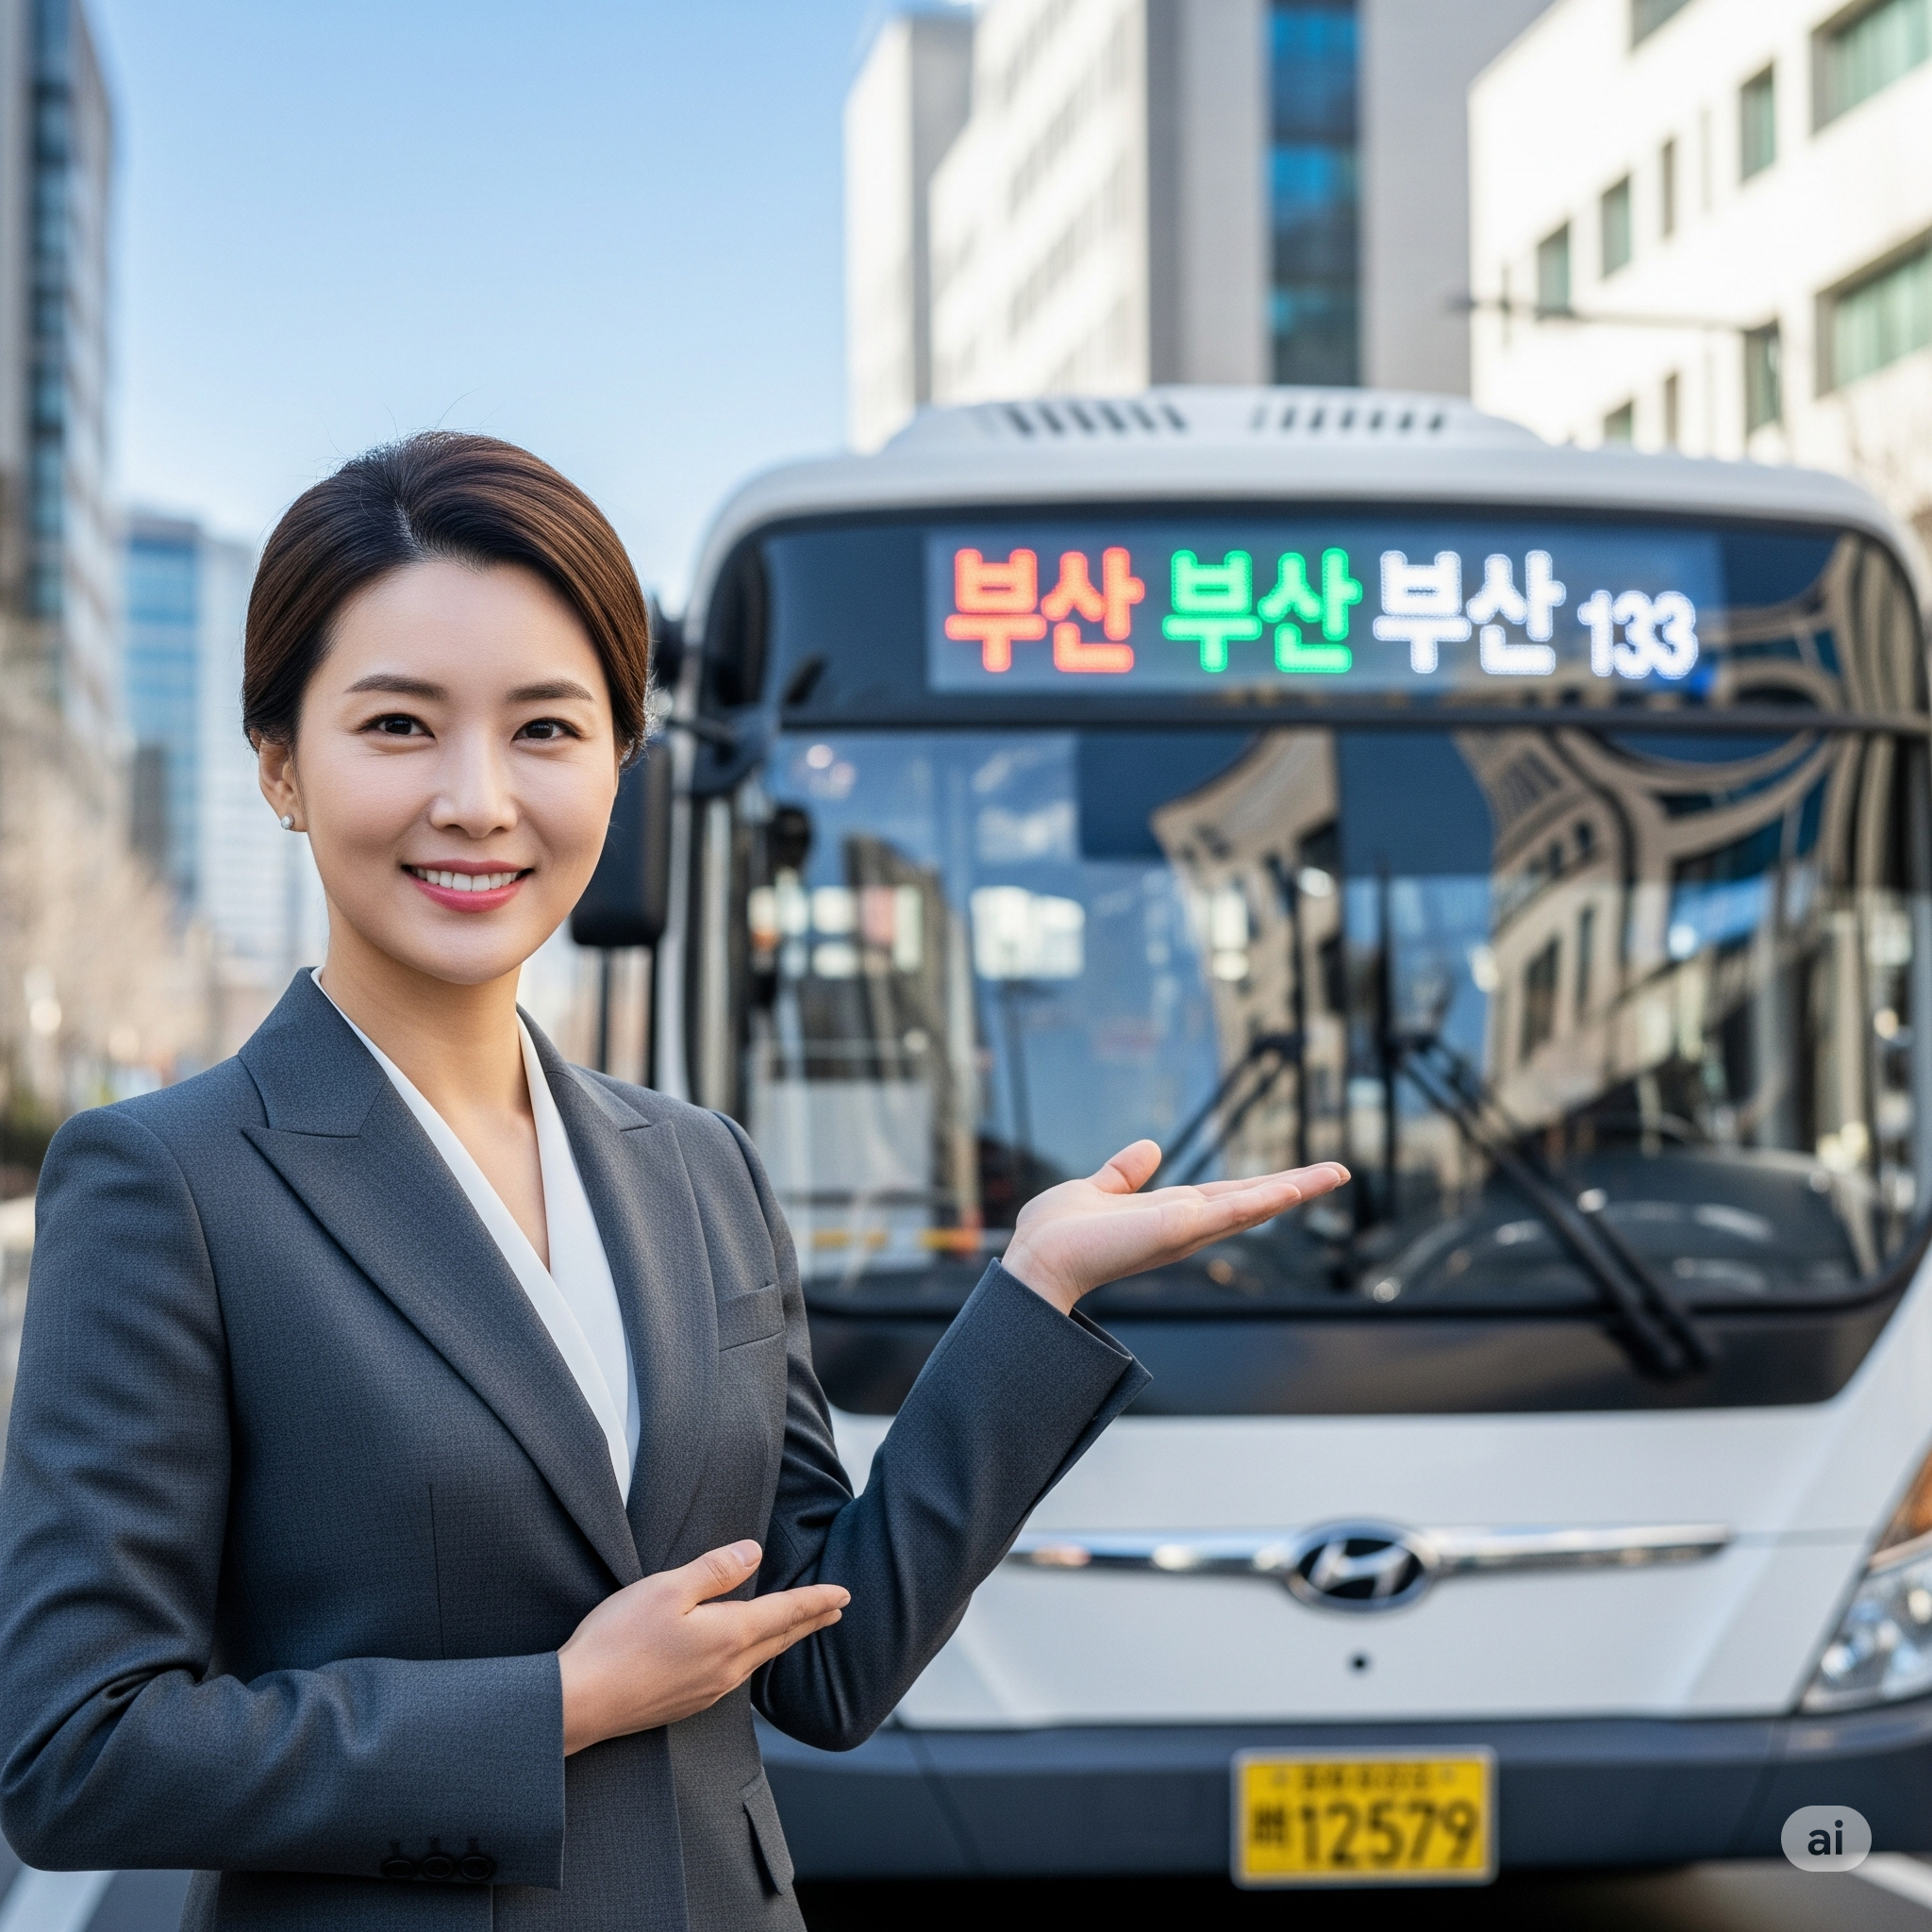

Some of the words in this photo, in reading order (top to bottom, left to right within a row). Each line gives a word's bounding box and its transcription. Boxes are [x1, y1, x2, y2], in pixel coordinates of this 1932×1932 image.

[945, 547, 1144, 673] 부산
[1162, 548, 1362, 674] 부산
[1373, 549, 1567, 675] 부산
[1577, 590, 1699, 680] 133
